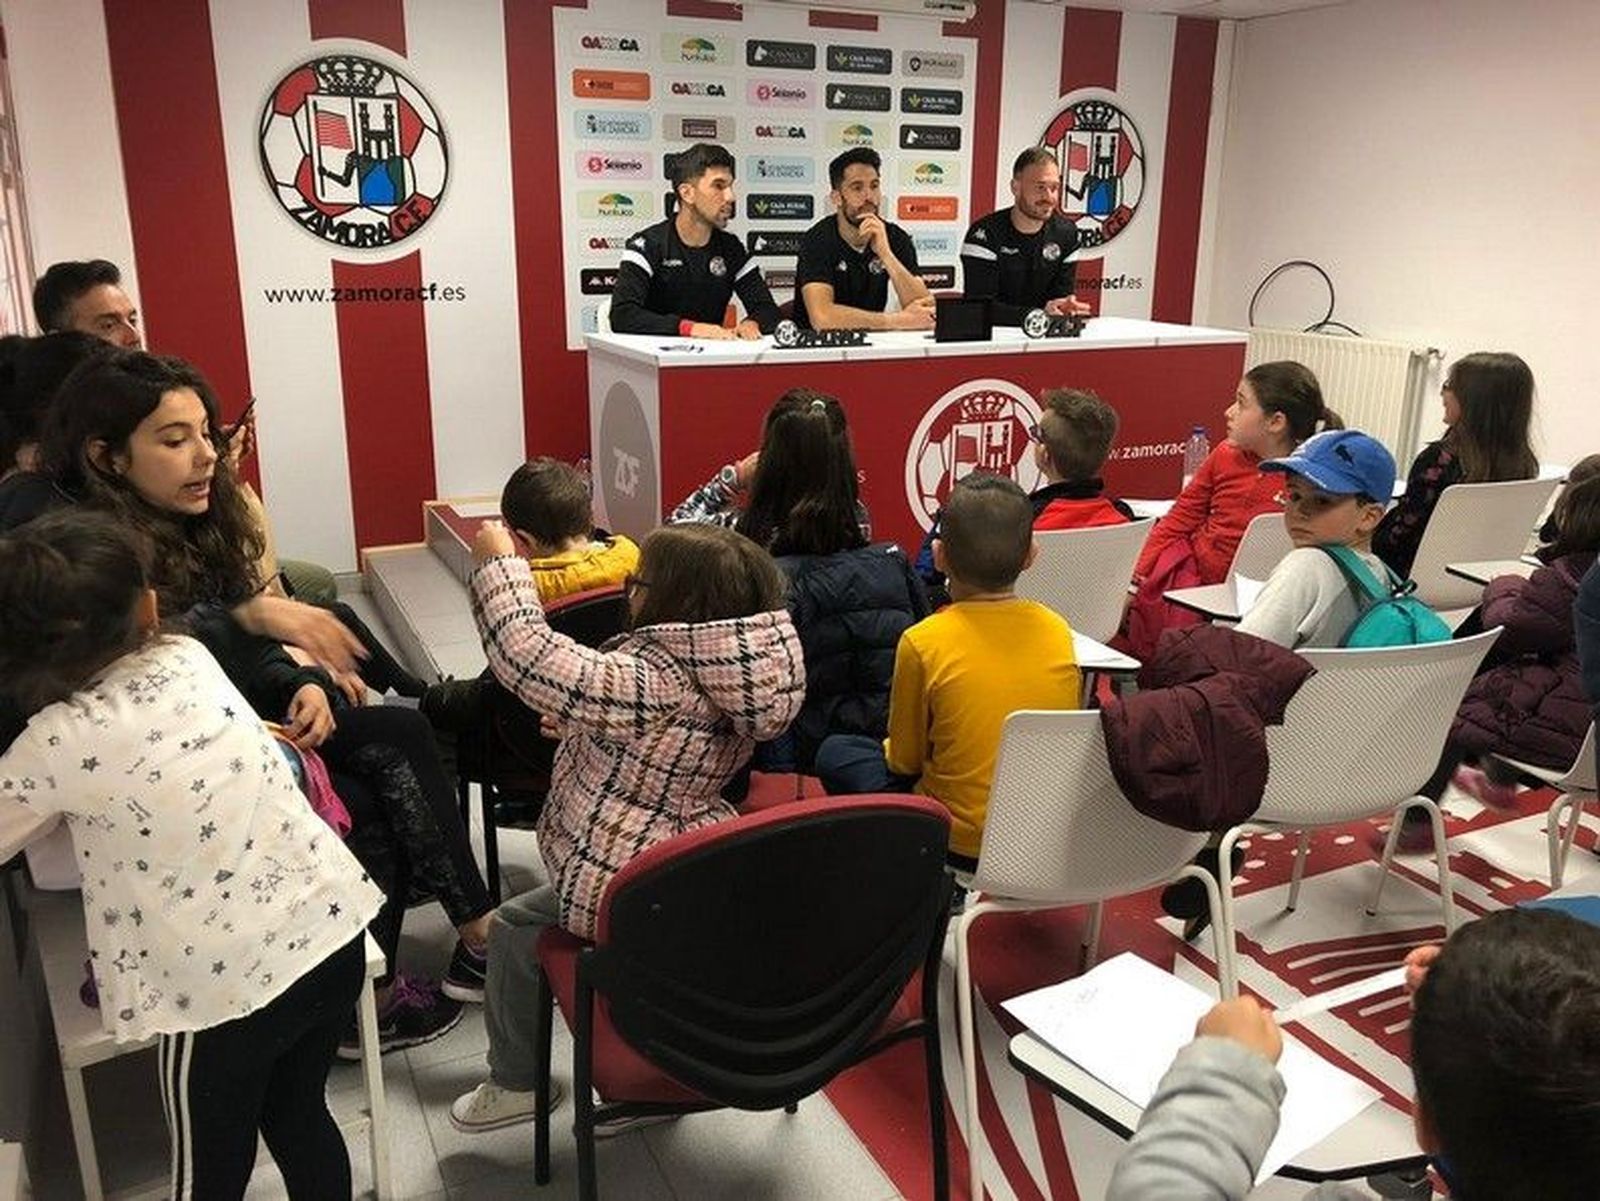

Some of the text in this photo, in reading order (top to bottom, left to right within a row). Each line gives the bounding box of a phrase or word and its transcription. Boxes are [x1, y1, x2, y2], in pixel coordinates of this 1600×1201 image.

[291, 201, 391, 247] ZAMORA
[264, 281, 466, 304] www.zamoracf.es
[1108, 442, 1187, 460] w.zamorac
